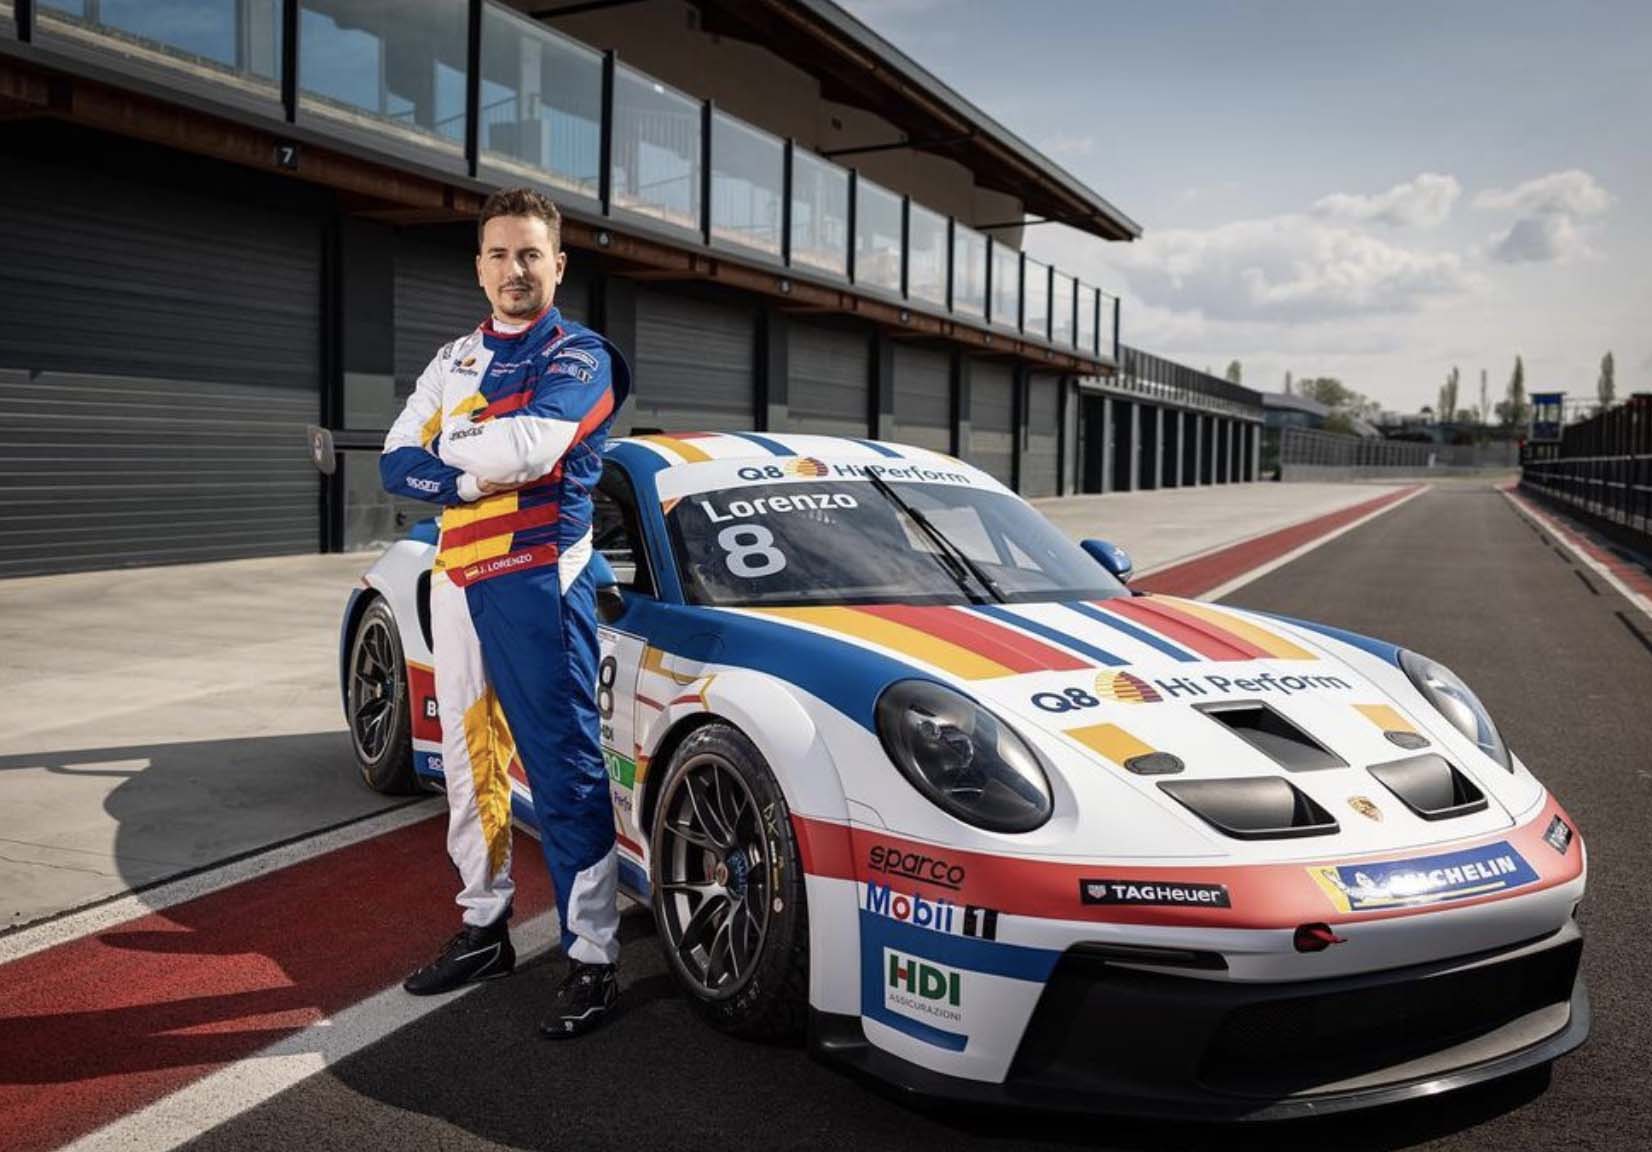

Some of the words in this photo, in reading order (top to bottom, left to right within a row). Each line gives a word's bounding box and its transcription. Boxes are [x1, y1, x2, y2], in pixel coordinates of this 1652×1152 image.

[281, 147, 292, 163] 7
[738, 463, 784, 482] Q8
[870, 464, 970, 484] Perform
[701, 491, 858, 523] Lorenzo
[488, 553, 532, 572] LORENZO
[718, 524, 786, 578] 8
[598, 655, 617, 720] 8
[1030, 688, 1101, 713] Q8
[1155, 676, 1202, 698] Hi
[1205, 671, 1353, 695] Perform
[869, 845, 965, 885] sparco
[1390, 856, 1517, 897] CHELIN
[866, 881, 953, 932] Mobil
[890, 954, 960, 1007] HDI
